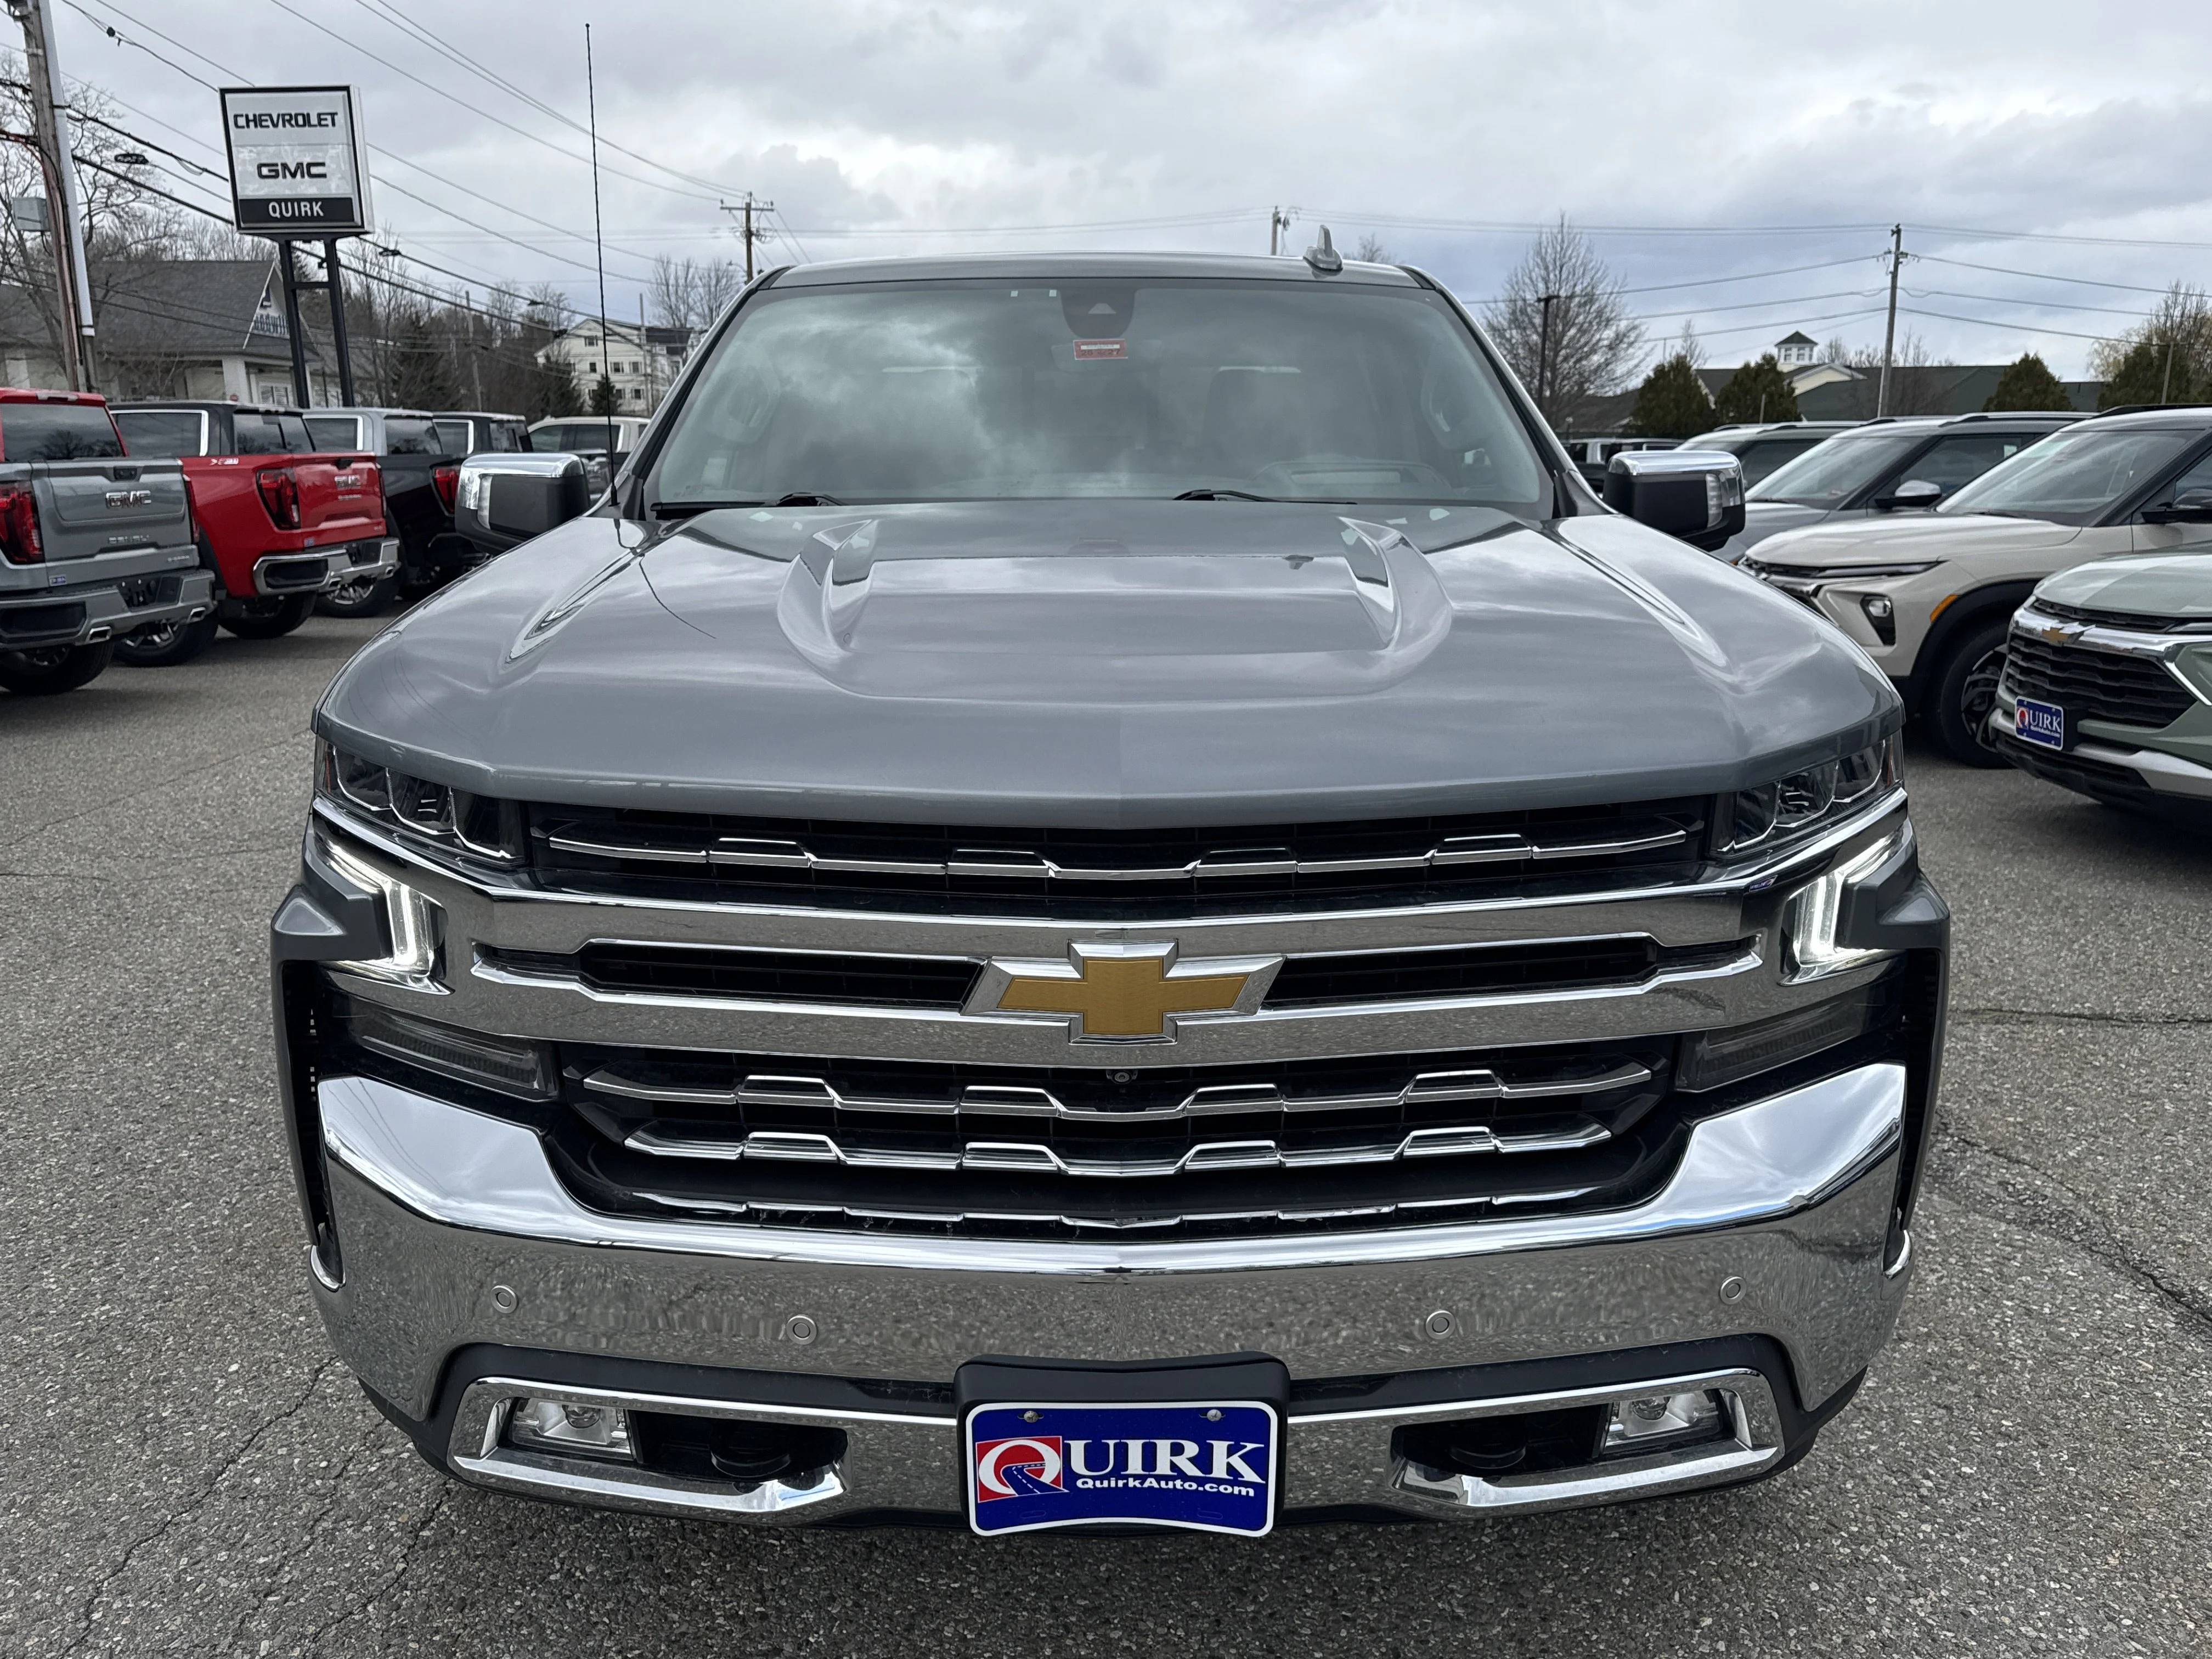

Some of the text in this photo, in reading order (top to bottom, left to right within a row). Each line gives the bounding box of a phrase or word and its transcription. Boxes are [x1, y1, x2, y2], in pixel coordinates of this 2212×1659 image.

[233, 112, 338, 129] CHEVROLET
[257, 161, 327, 179] GMC
[268, 201, 324, 218] QUIRK
[105, 490, 152, 509] GMC
[2017, 707, 2061, 733] QUIRK
[978, 1438, 1266, 1497] QUIRK
[1076, 1477, 1255, 1497] QuirkAuto.com
